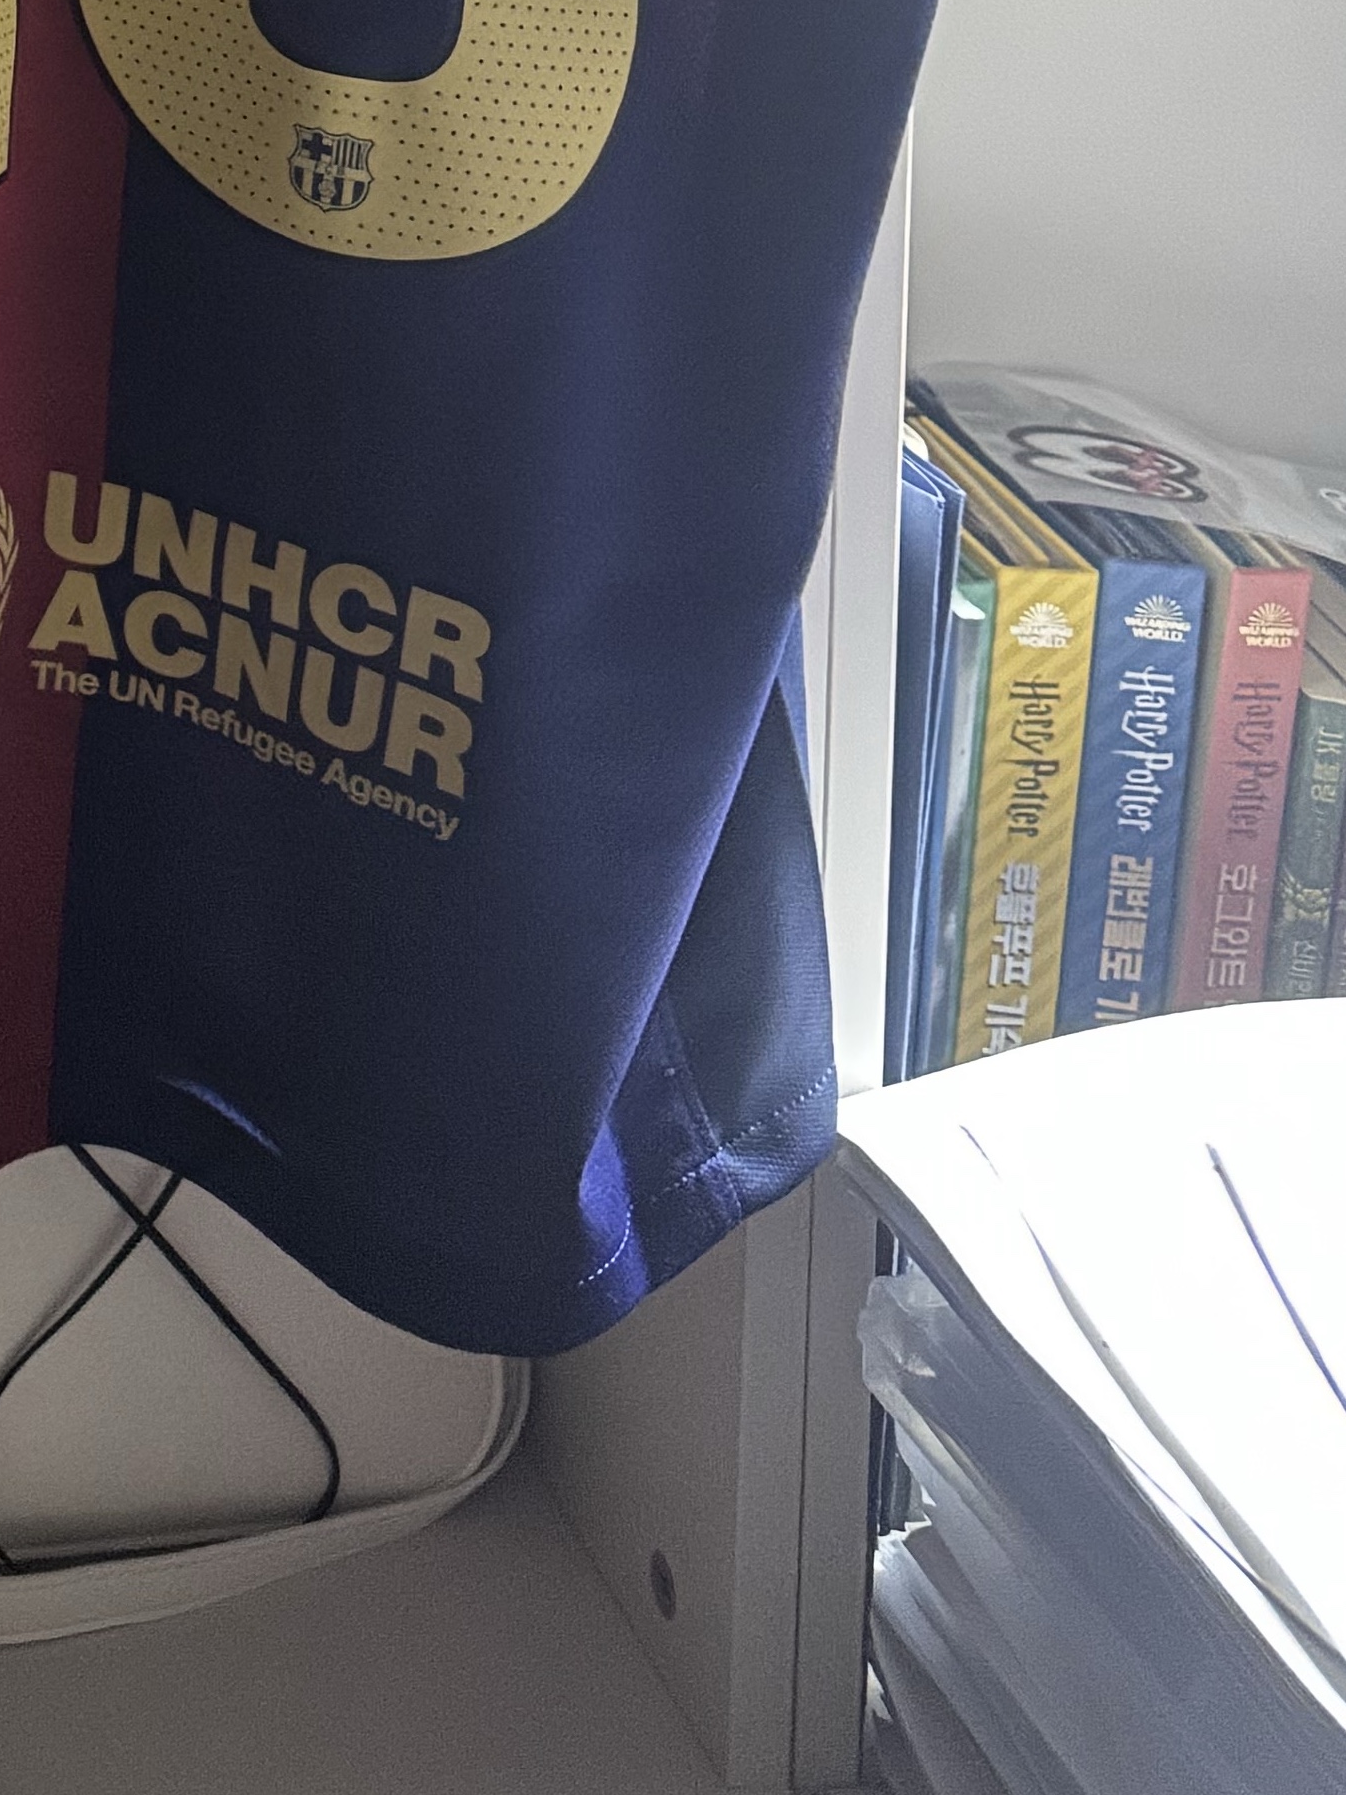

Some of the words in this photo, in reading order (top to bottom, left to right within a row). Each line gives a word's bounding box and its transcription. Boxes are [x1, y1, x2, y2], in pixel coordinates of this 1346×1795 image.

[44, 470, 492, 703] UNHCR
[28, 570, 474, 799] ACNUR
[1009, 674, 1061, 755] Harry
[1119, 665, 1176, 748] Harry
[1232, 681, 1282, 756] Harry
[30, 659, 100, 697] The
[108, 670, 166, 712] UN
[174, 690, 317, 776] Refugee
[321, 757, 459, 841] Agency
[1110, 748, 1174, 835] Potter
[1005, 758, 1060, 838] Potter
[1225, 760, 1280, 841] Potter
[1099, 853, 1154, 982] 래번클로
[1208, 863, 1257, 988] 호그와트
